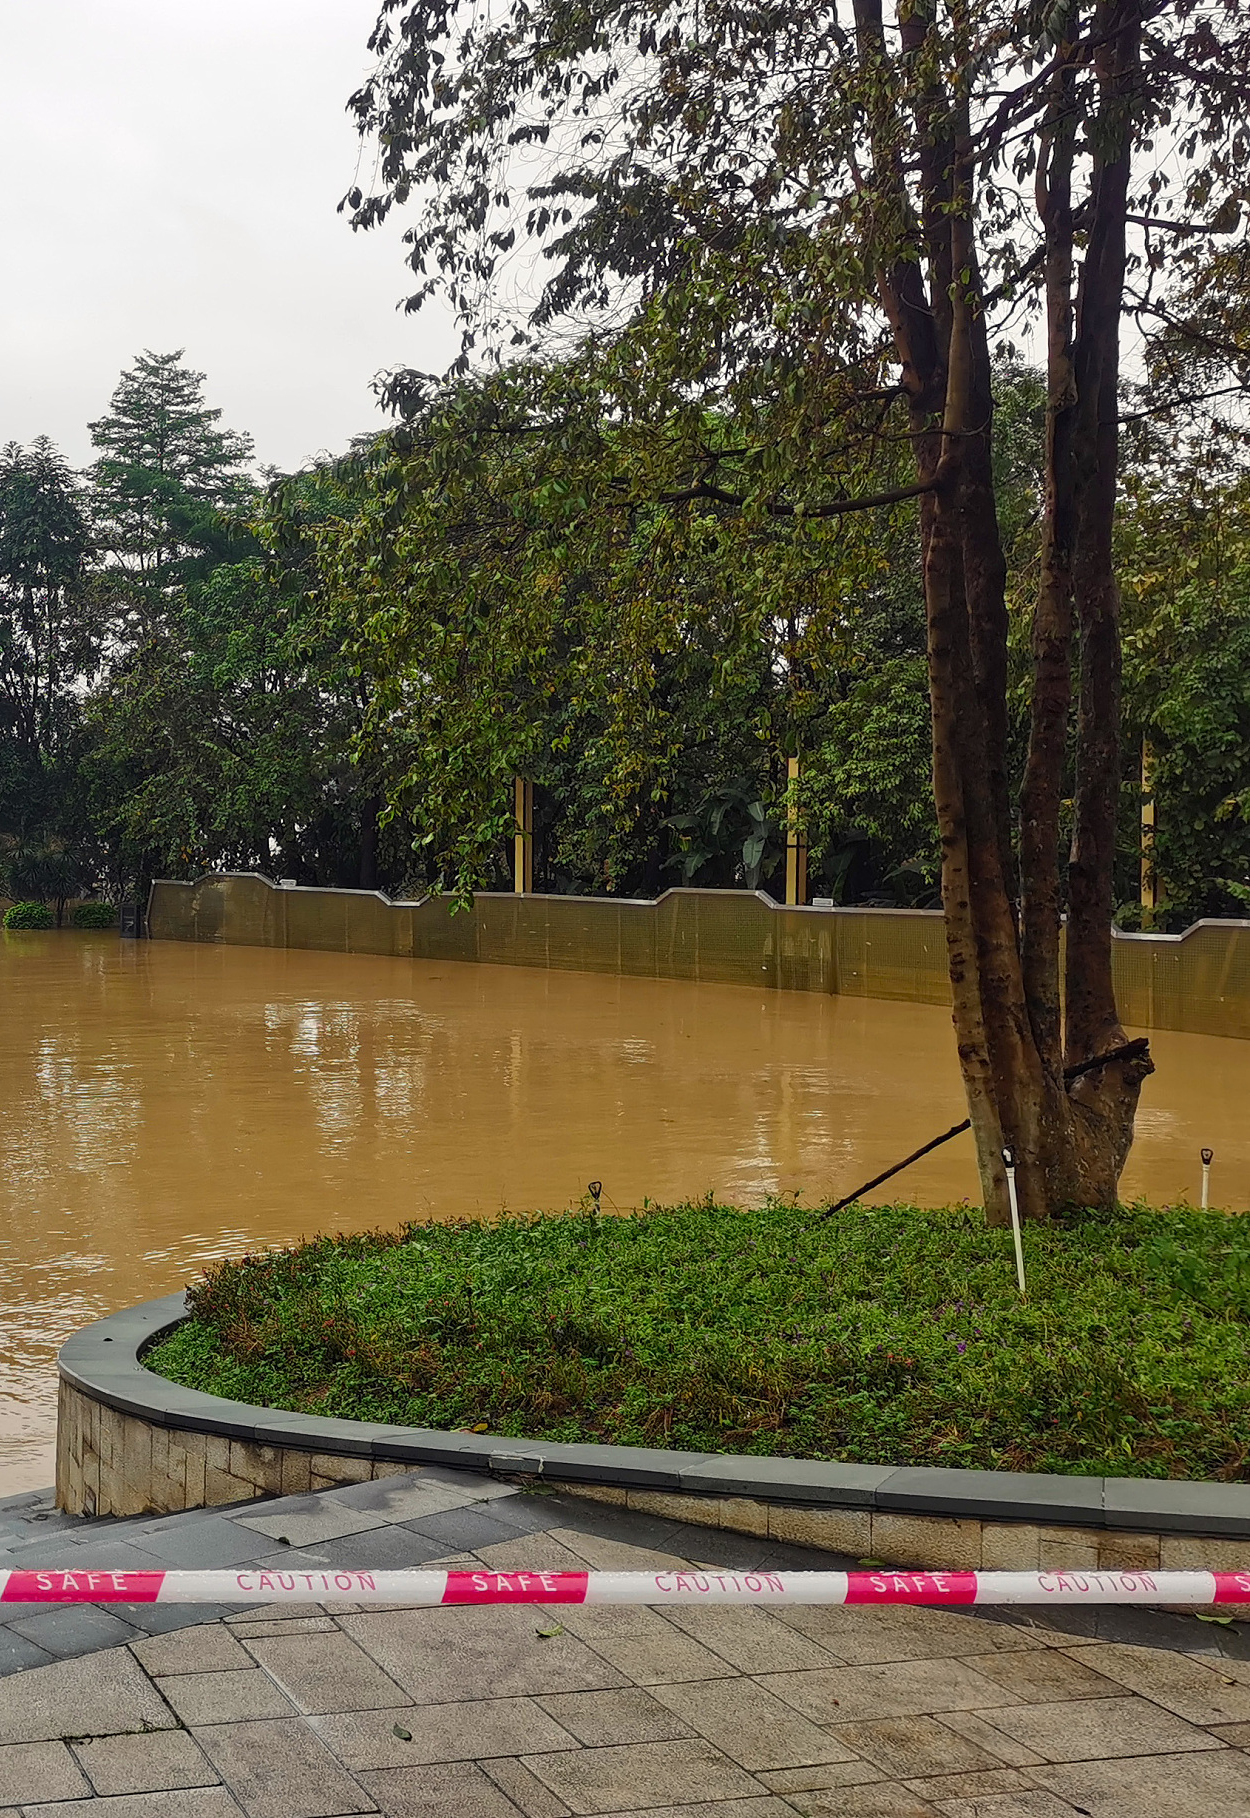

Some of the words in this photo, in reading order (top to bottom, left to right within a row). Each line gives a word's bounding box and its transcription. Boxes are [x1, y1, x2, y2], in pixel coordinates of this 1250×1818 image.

[36, 1573, 128, 1591] SAFE
[236, 1573, 377, 1591] CAUTION
[471, 1574, 558, 1592] SAFE
[654, 1575, 785, 1592] CAUTION
[869, 1575, 950, 1593] SAFE
[1038, 1575, 1158, 1592] CAUTION
